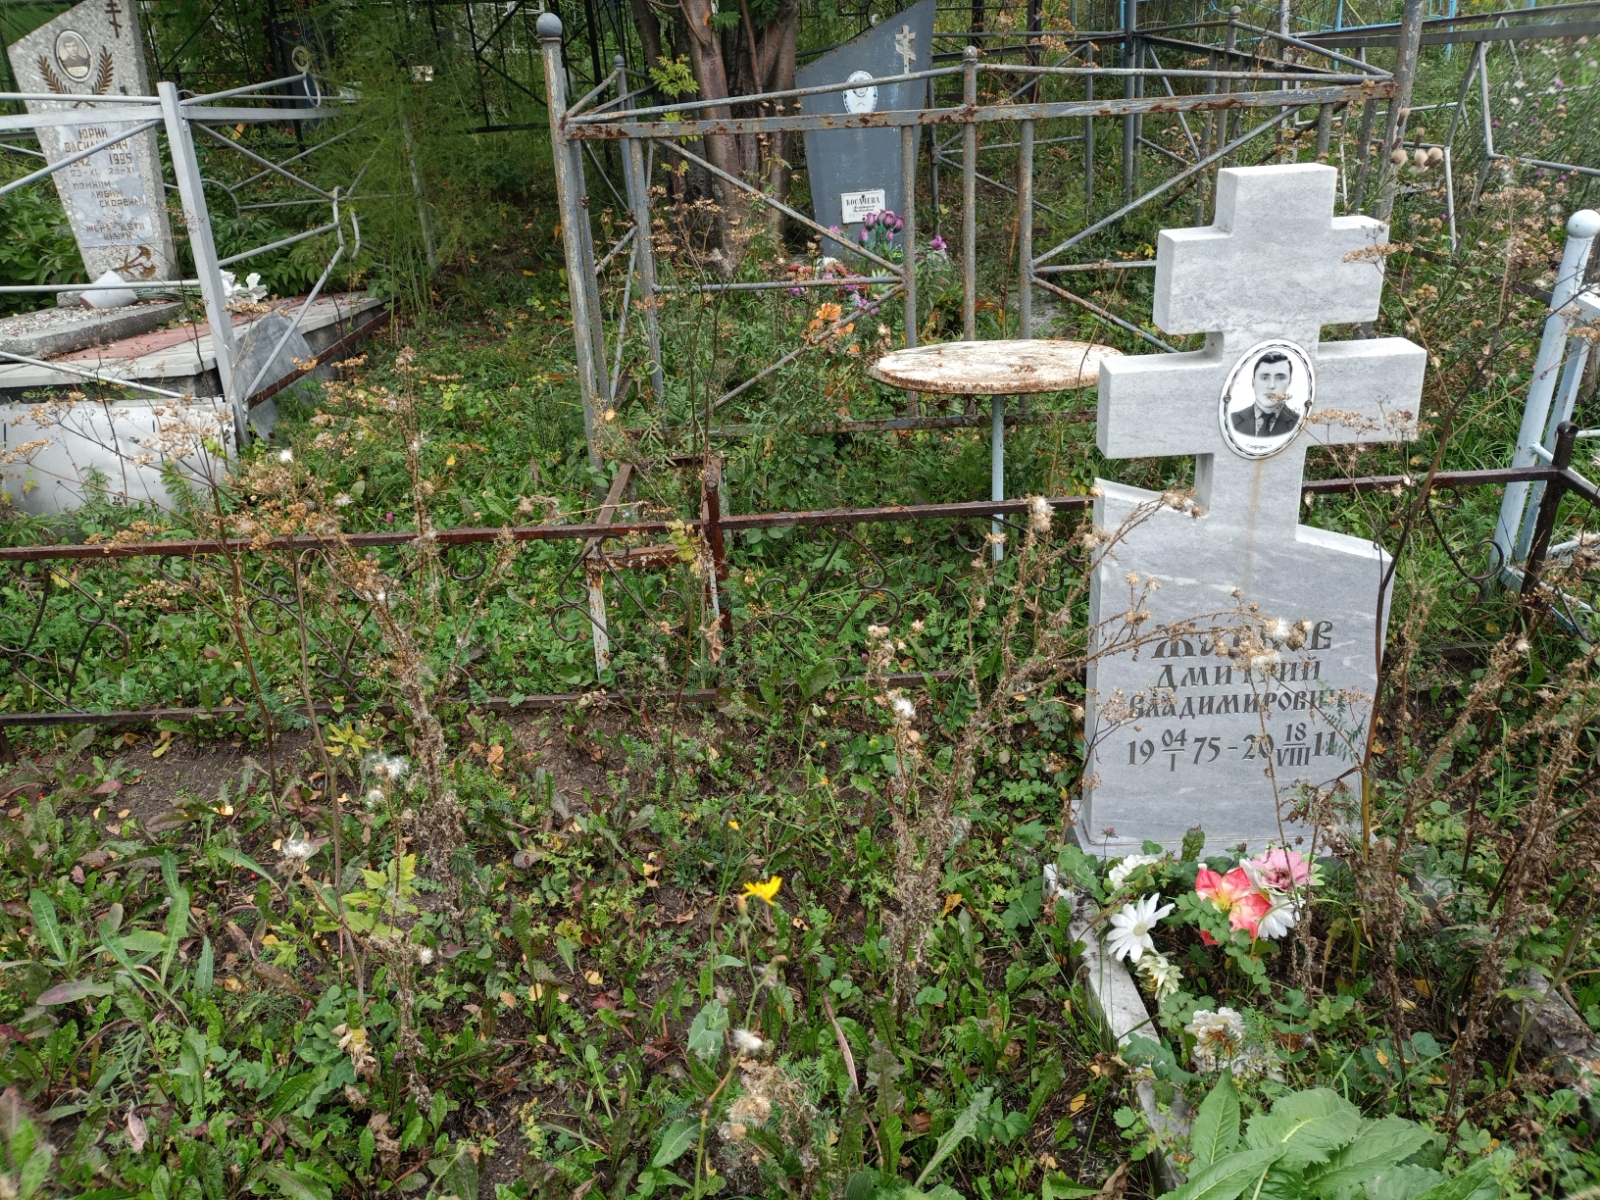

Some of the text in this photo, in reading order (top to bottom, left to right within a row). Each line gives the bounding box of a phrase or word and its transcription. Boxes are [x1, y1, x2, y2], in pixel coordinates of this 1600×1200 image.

[78, 125, 109, 139] ЮРИЙ
[64, 138, 129, 153] ВАСИЛВИЧ
[109, 153, 133, 165] 1995
[91, 189, 123, 199] ЛЮБИМ
